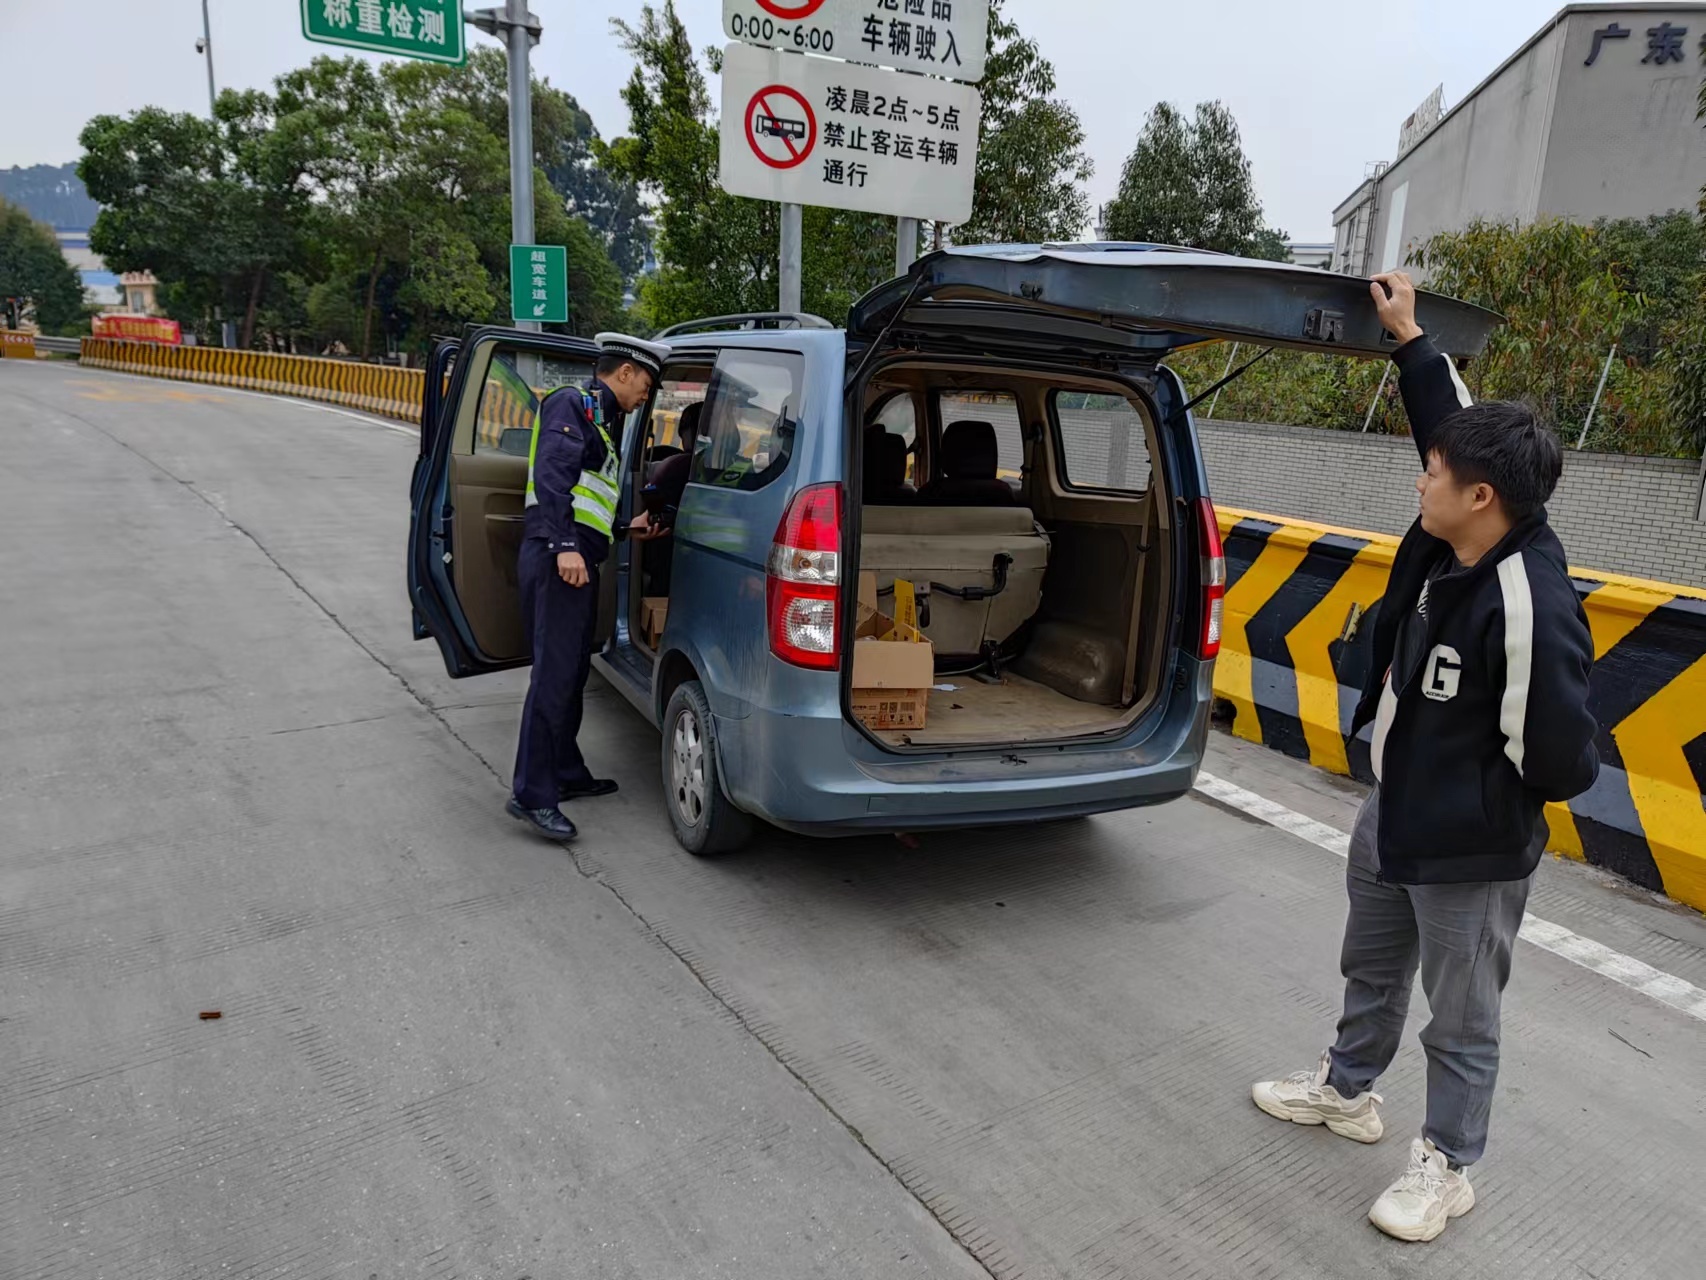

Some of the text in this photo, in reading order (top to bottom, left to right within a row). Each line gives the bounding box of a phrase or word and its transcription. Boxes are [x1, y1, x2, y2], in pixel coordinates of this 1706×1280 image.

[323, 0, 445, 45] 称重检测
[731, 13, 834, 52] 0:00~6:00
[861, 13, 962, 67] 车辆驶入
[1583, 22, 1706, 66] 广东
[825, 85, 961, 132] 凌晨2点~5点
[823, 121, 959, 166] 禁止客运车辆
[822, 158, 869, 188] 通行
[1421, 644, 1461, 701] G
